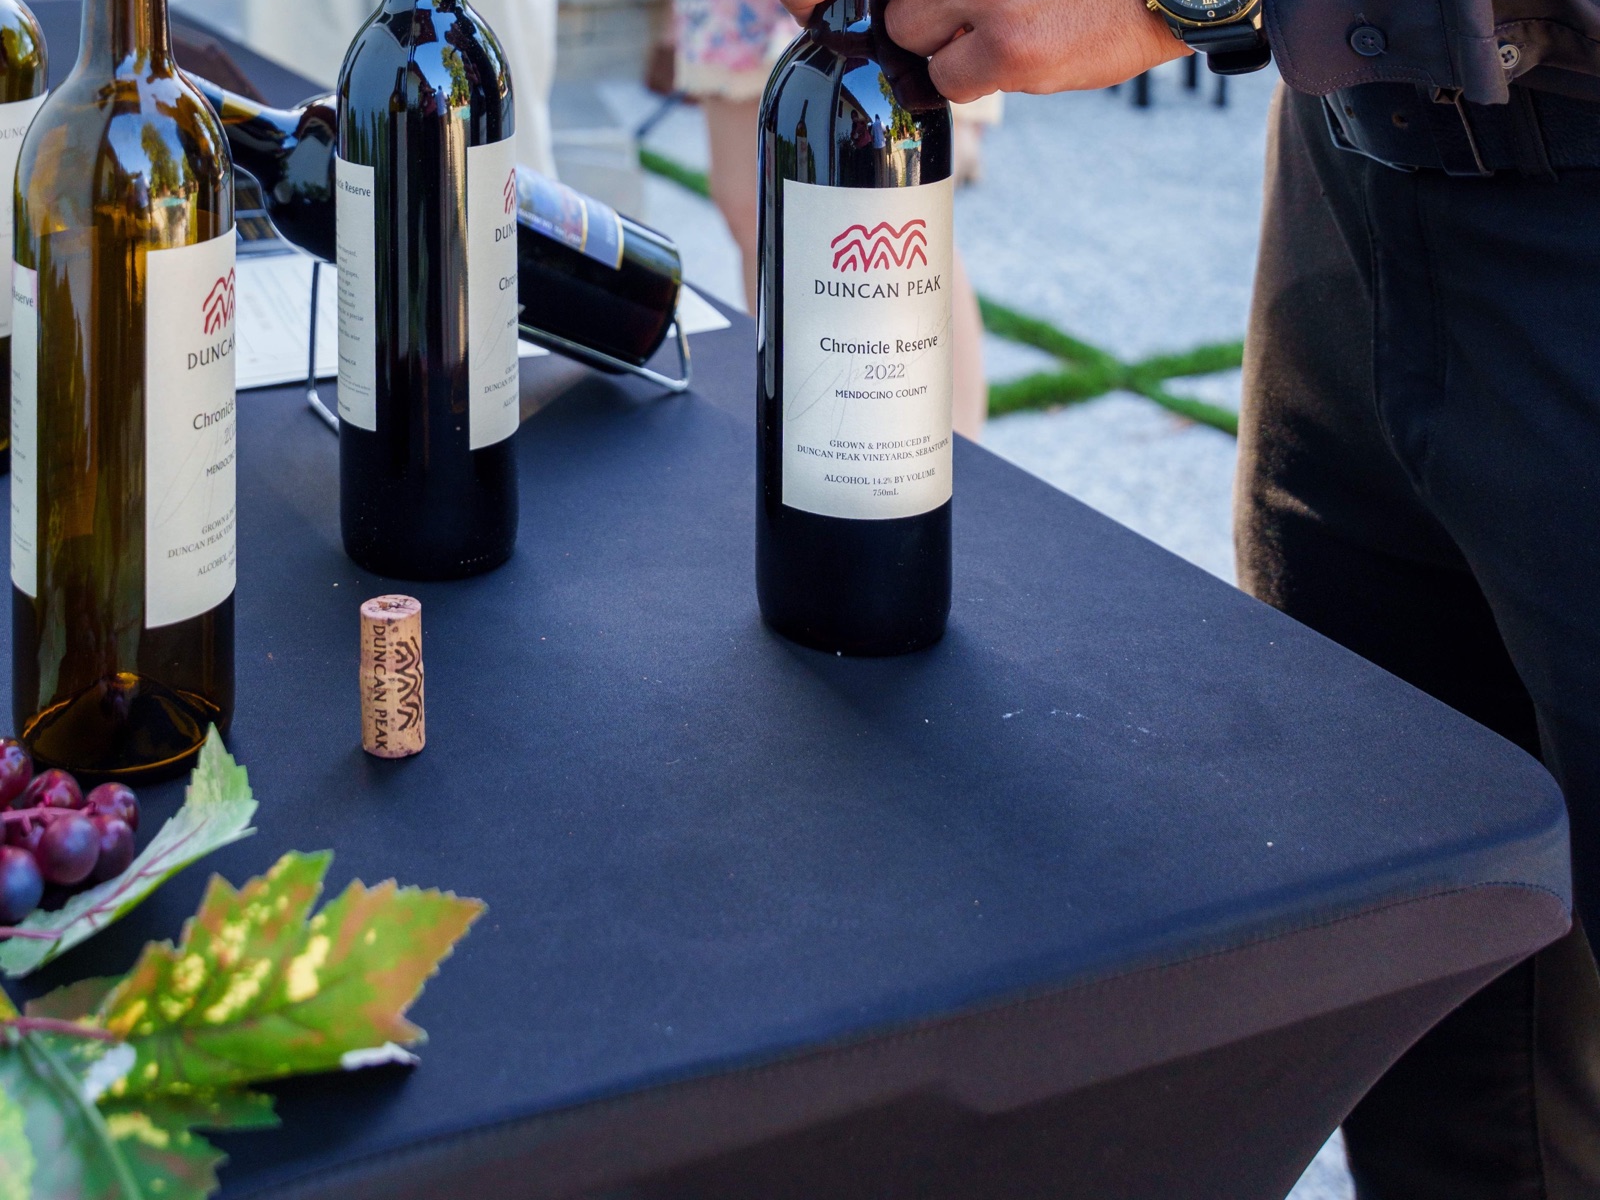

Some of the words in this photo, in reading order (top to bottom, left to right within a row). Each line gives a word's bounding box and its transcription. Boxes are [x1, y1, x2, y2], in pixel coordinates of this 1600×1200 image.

[345, 180, 371, 197] Reserve
[814, 279, 899, 299] DUNCAN
[907, 274, 941, 297] PEAK
[820, 337, 890, 355] Chronicle
[895, 335, 938, 354] Reserve
[864, 363, 905, 380] 2022
[835, 389, 894, 400] MENDOCINO
[895, 385, 928, 399] COUNTY
[829, 439, 866, 450] GROWN
[867, 442, 874, 450] &
[876, 437, 922, 450] PRODUCED
[922, 434, 931, 444] BY
[797, 444, 834, 459] DUNCAN
[836, 452, 861, 461] PEAK
[862, 450, 914, 462] VINEYARDS,
[824, 473, 870, 485] ALCOHOL
[872, 477, 893, 485] 14.2%
[894, 476, 905, 484] BY
[906, 467, 936, 482] VOLUME
[872, 488, 899, 497] 750mL
[168, 540, 205, 559] DUNCAN
[372, 625, 387, 702] DUNCAN
[374, 709, 389, 751] PEAK
